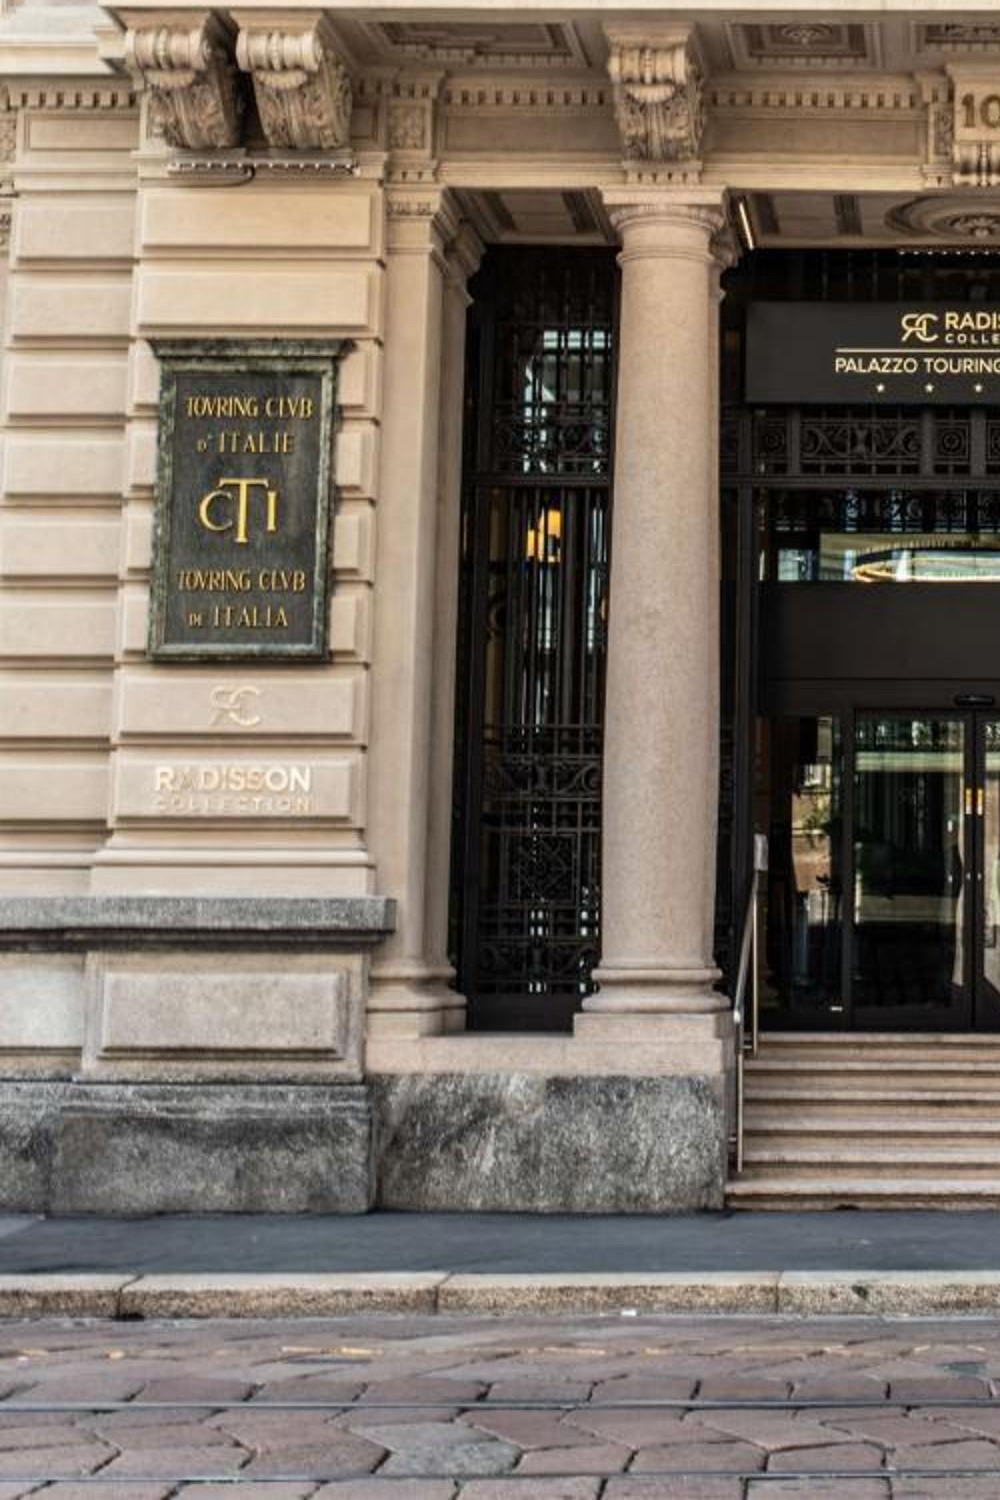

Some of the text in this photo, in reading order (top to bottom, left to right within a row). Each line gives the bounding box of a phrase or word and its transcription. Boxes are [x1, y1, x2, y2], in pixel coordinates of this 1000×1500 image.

[835, 357, 918, 375] PALAZZO
[213, 604, 289, 628] ITALIA
[154, 765, 312, 793] RADISSON
